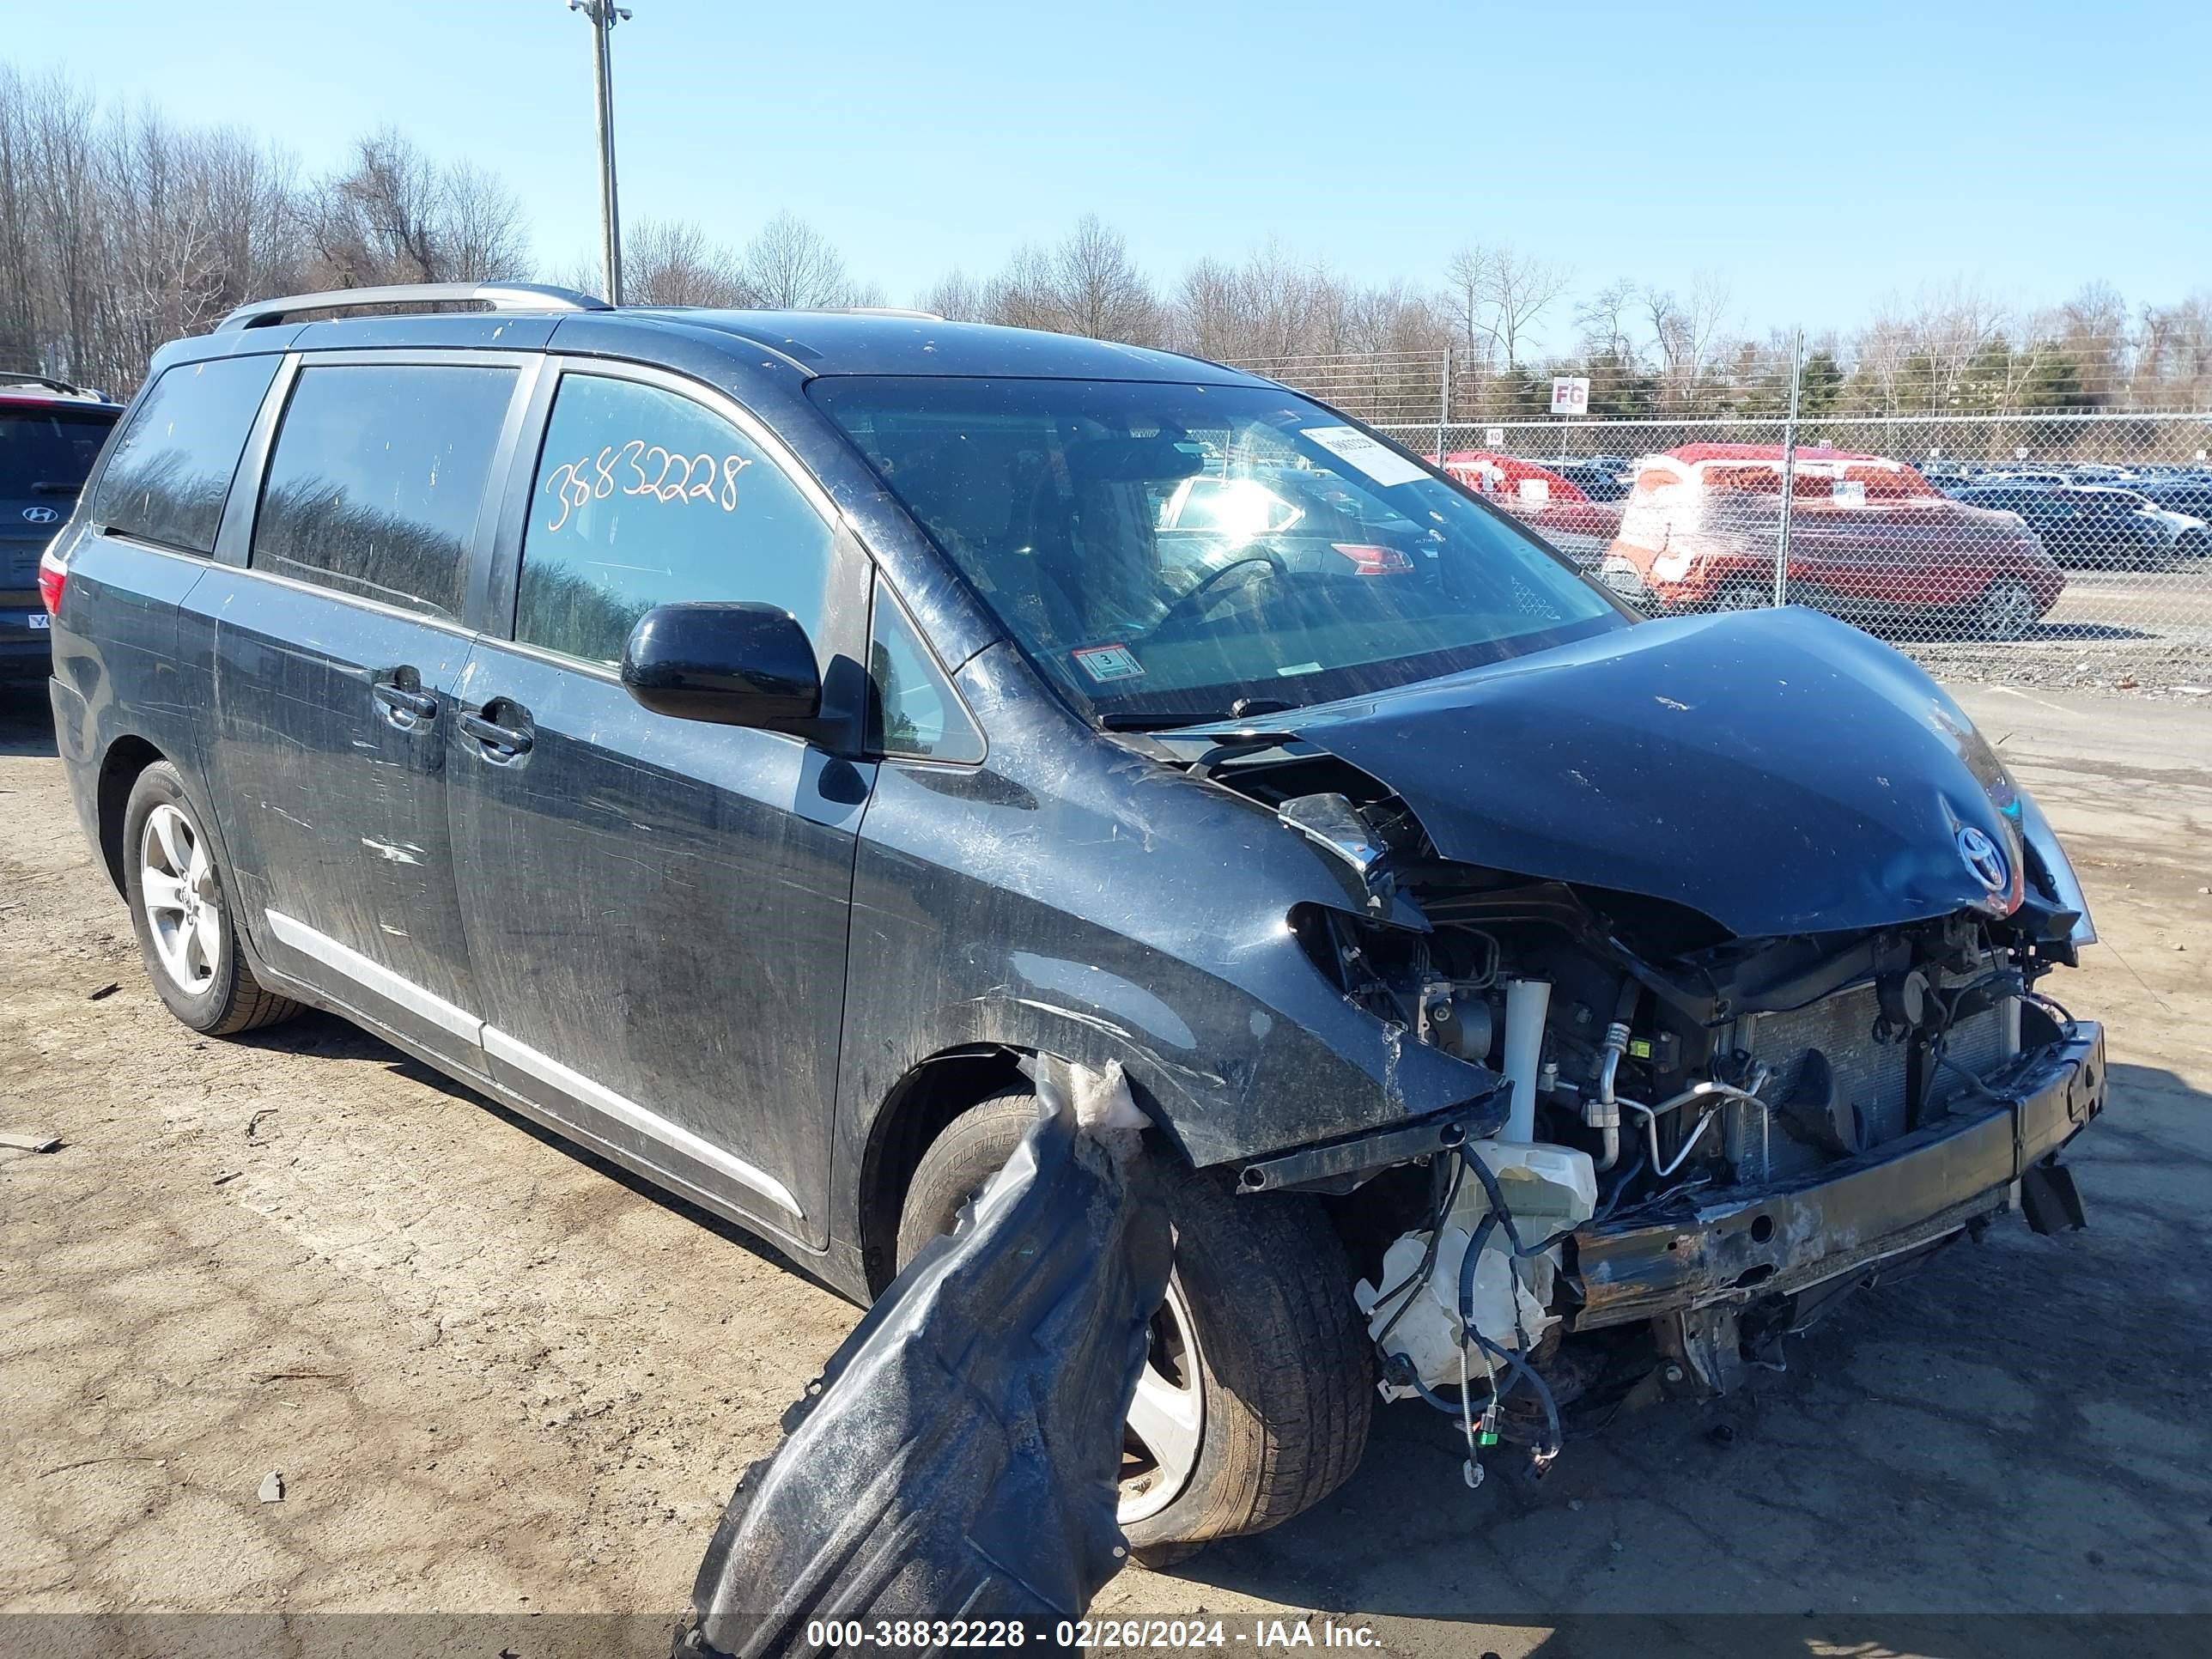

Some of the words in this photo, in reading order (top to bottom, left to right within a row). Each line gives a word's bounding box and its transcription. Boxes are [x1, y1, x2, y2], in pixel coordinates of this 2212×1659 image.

[1556, 385, 1585, 405] FG
[1489, 432, 1501, 441] 10
[544, 439, 753, 532] 38832228
